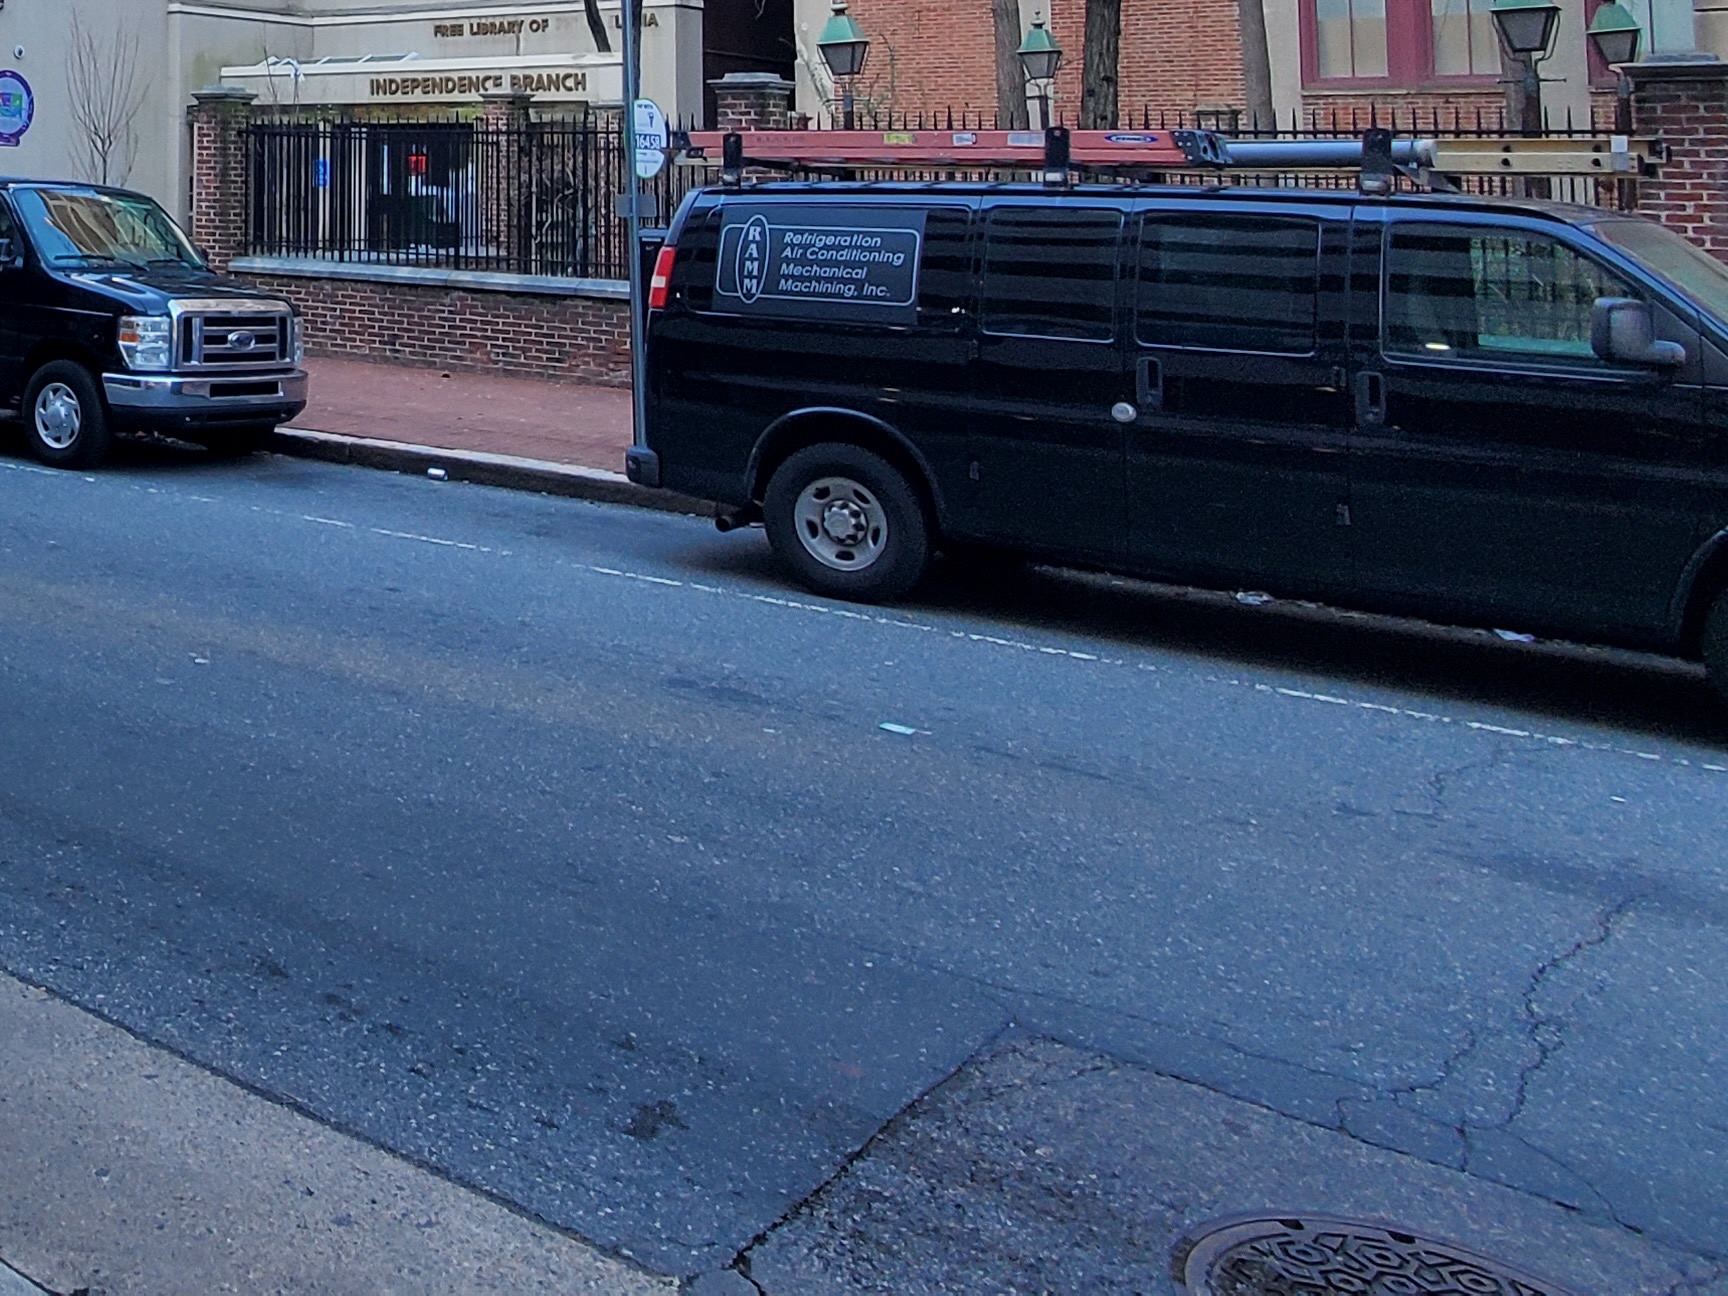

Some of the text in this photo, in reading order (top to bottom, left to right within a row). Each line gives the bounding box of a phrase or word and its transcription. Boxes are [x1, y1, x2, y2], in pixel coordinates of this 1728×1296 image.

[434, 24, 464, 38] FREE
[469, 19, 525, 36] LIBRARY
[529, 19, 550, 33] OF
[370, 72, 587, 96] INDEPENDENCE BRANCH
[783, 232, 881, 247] Refrigeration
[743, 226, 761, 294] RAMM
[781, 247, 905, 266] Air Conditioning
[779, 263, 867, 279] Mechanical
[778, 279, 891, 297] Machining, Inc.
